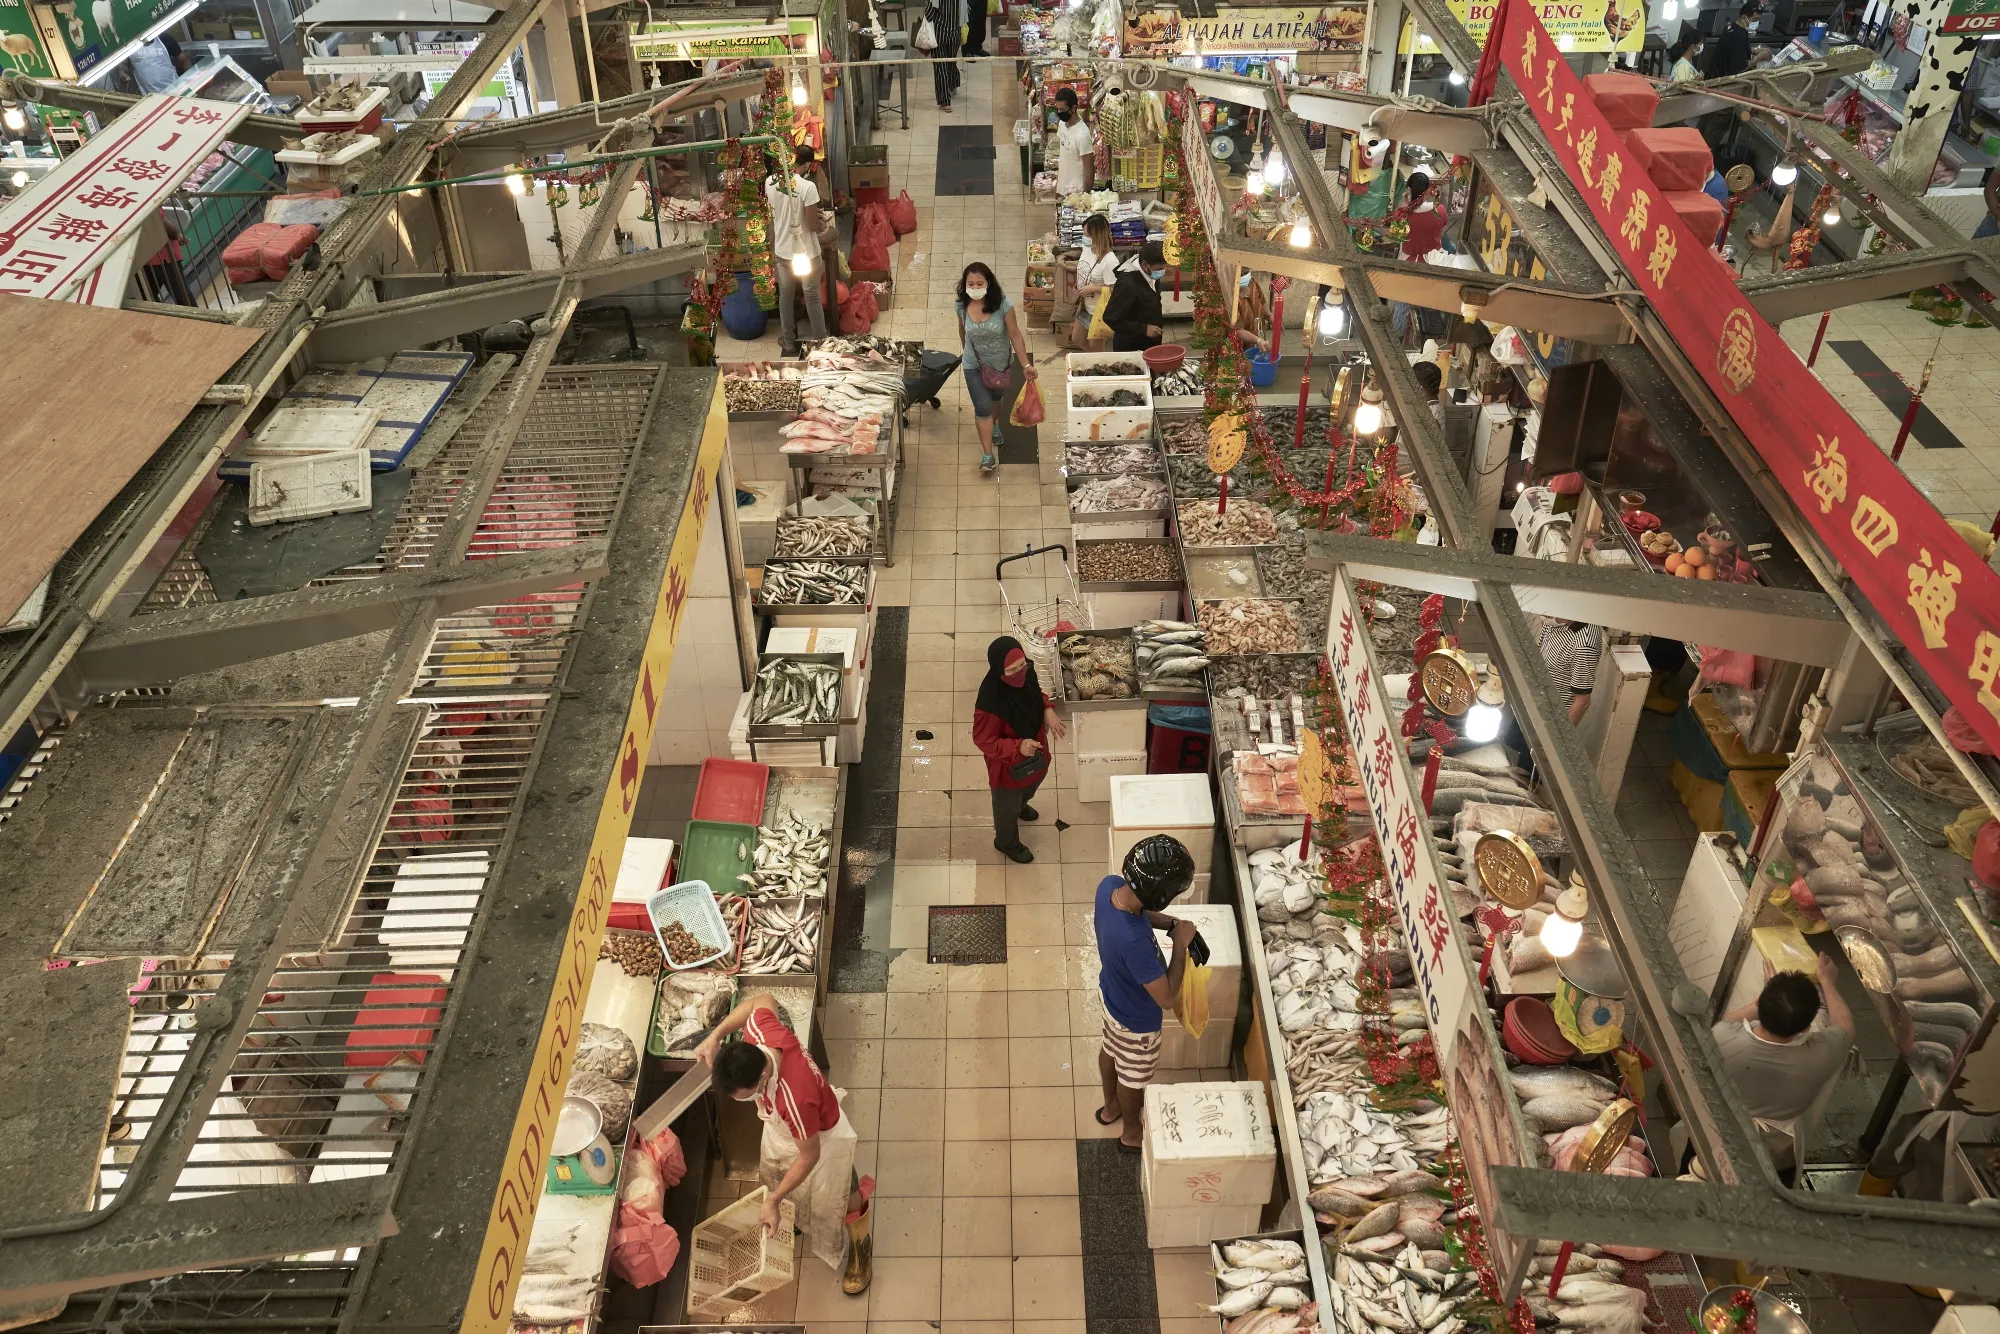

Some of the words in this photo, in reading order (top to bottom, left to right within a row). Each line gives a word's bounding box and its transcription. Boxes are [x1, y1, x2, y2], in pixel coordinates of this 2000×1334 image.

[1252, 20, 1329, 39] LATIFAH
[1556, 22, 1579, 30] Ayam
[1581, 21, 1602, 29] Halal
[77, 52, 97, 70] 126/127
[620, 660, 659, 815] 81
[1331, 643, 1348, 700] LEE
[1348, 696, 1363, 752] YIT
[1363, 753, 1389, 844] HUAT
[1390, 848, 1440, 1026] TRADING
